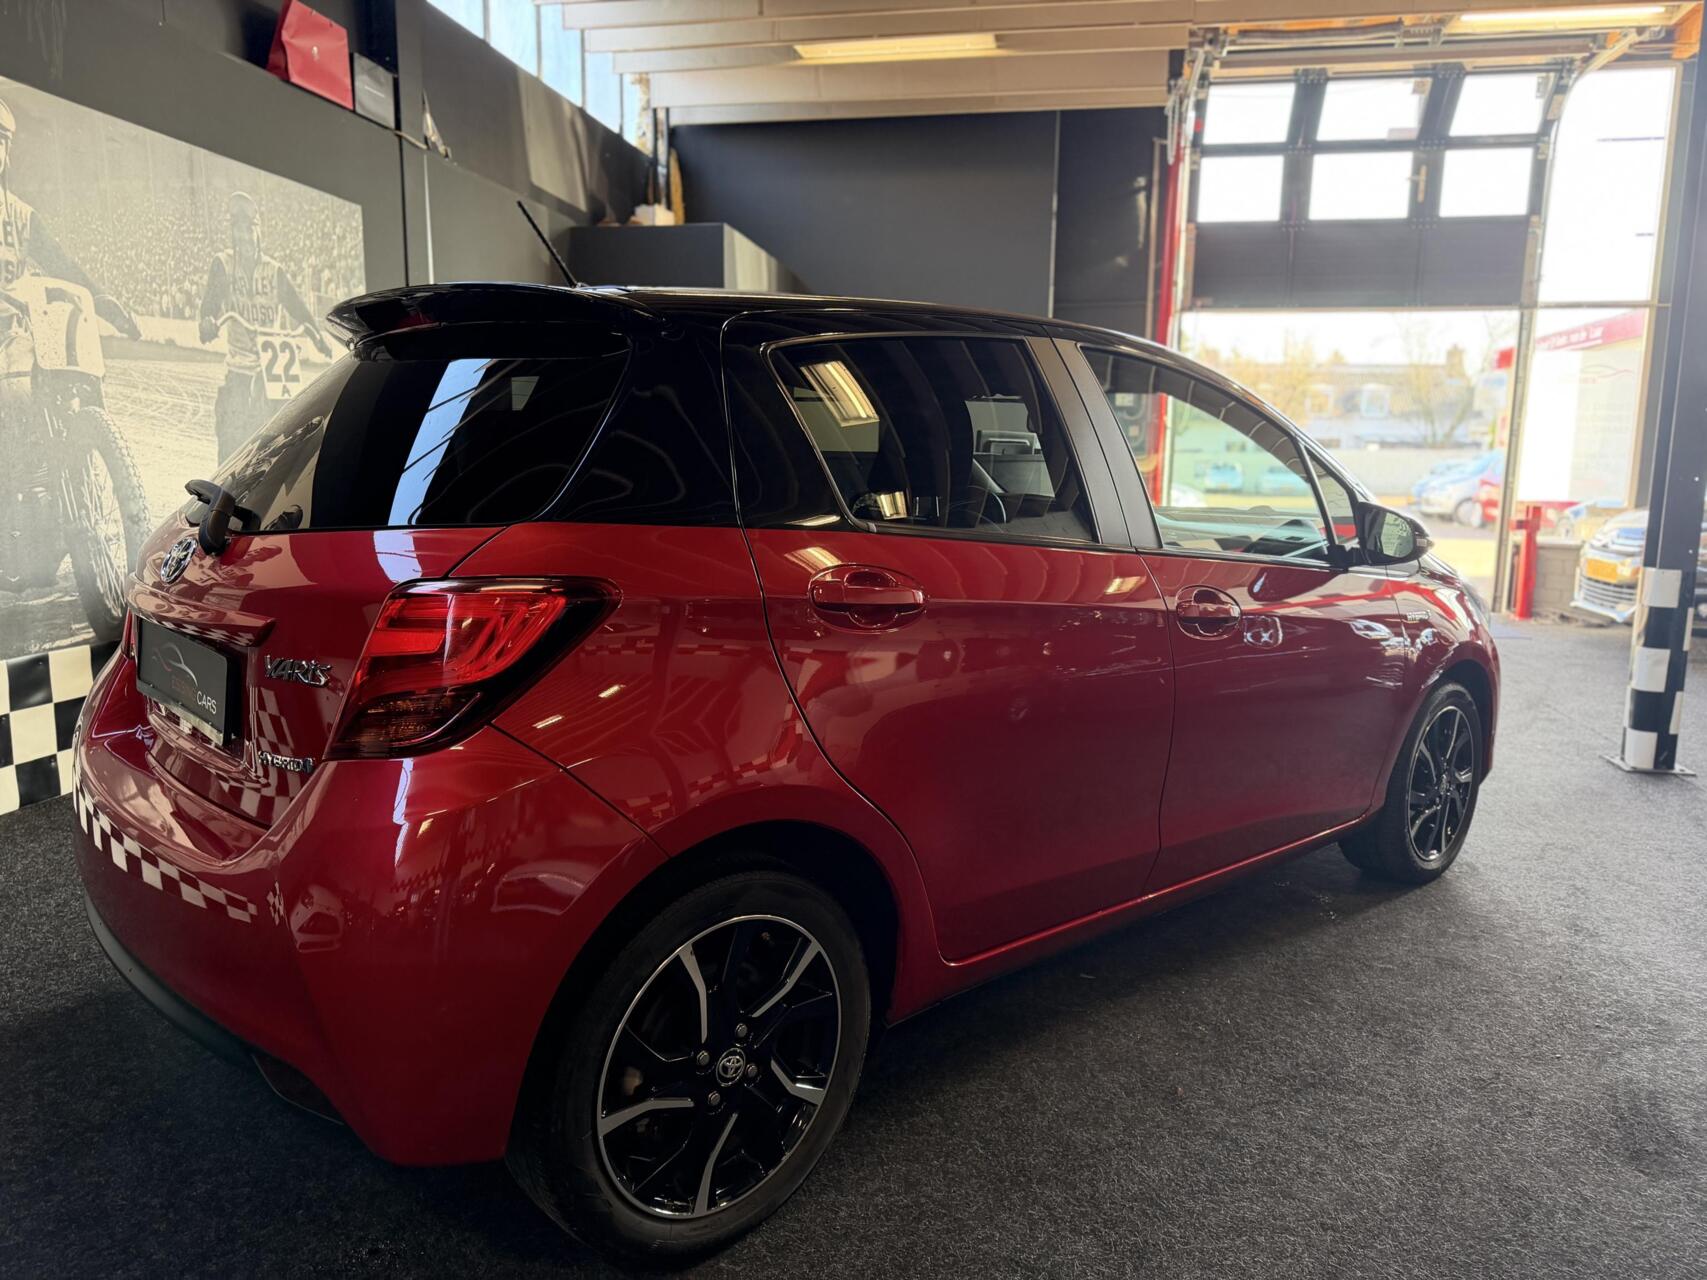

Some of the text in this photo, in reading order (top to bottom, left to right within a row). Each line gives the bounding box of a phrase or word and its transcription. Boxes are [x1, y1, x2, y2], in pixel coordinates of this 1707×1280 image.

[45, 286, 82, 368] 7
[261, 340, 300, 383] 22
[281, 383, 292, 398] A
[196, 690, 217, 715] CARS
[258, 750, 304, 772] HYBRID
